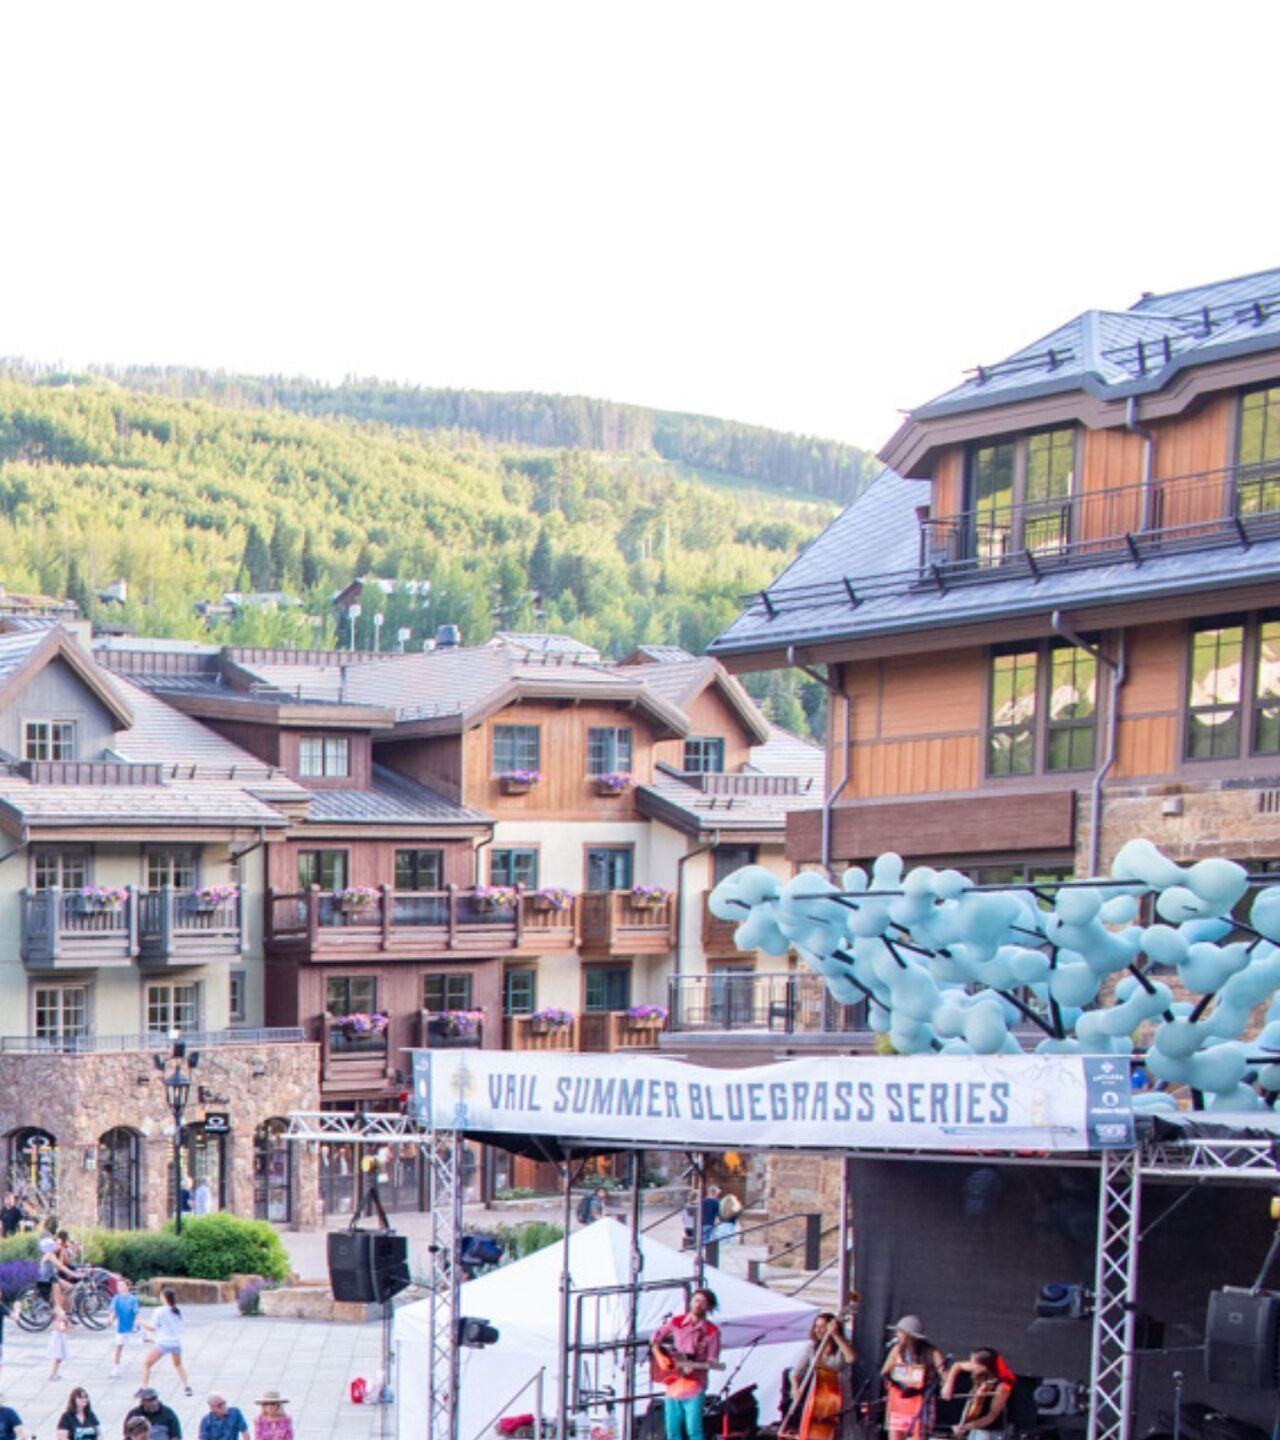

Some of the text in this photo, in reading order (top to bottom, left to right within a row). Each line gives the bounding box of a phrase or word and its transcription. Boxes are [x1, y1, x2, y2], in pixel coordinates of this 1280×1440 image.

[488, 1073, 1011, 1123] VAIL SUMMER BLUEGRASS SERIES
